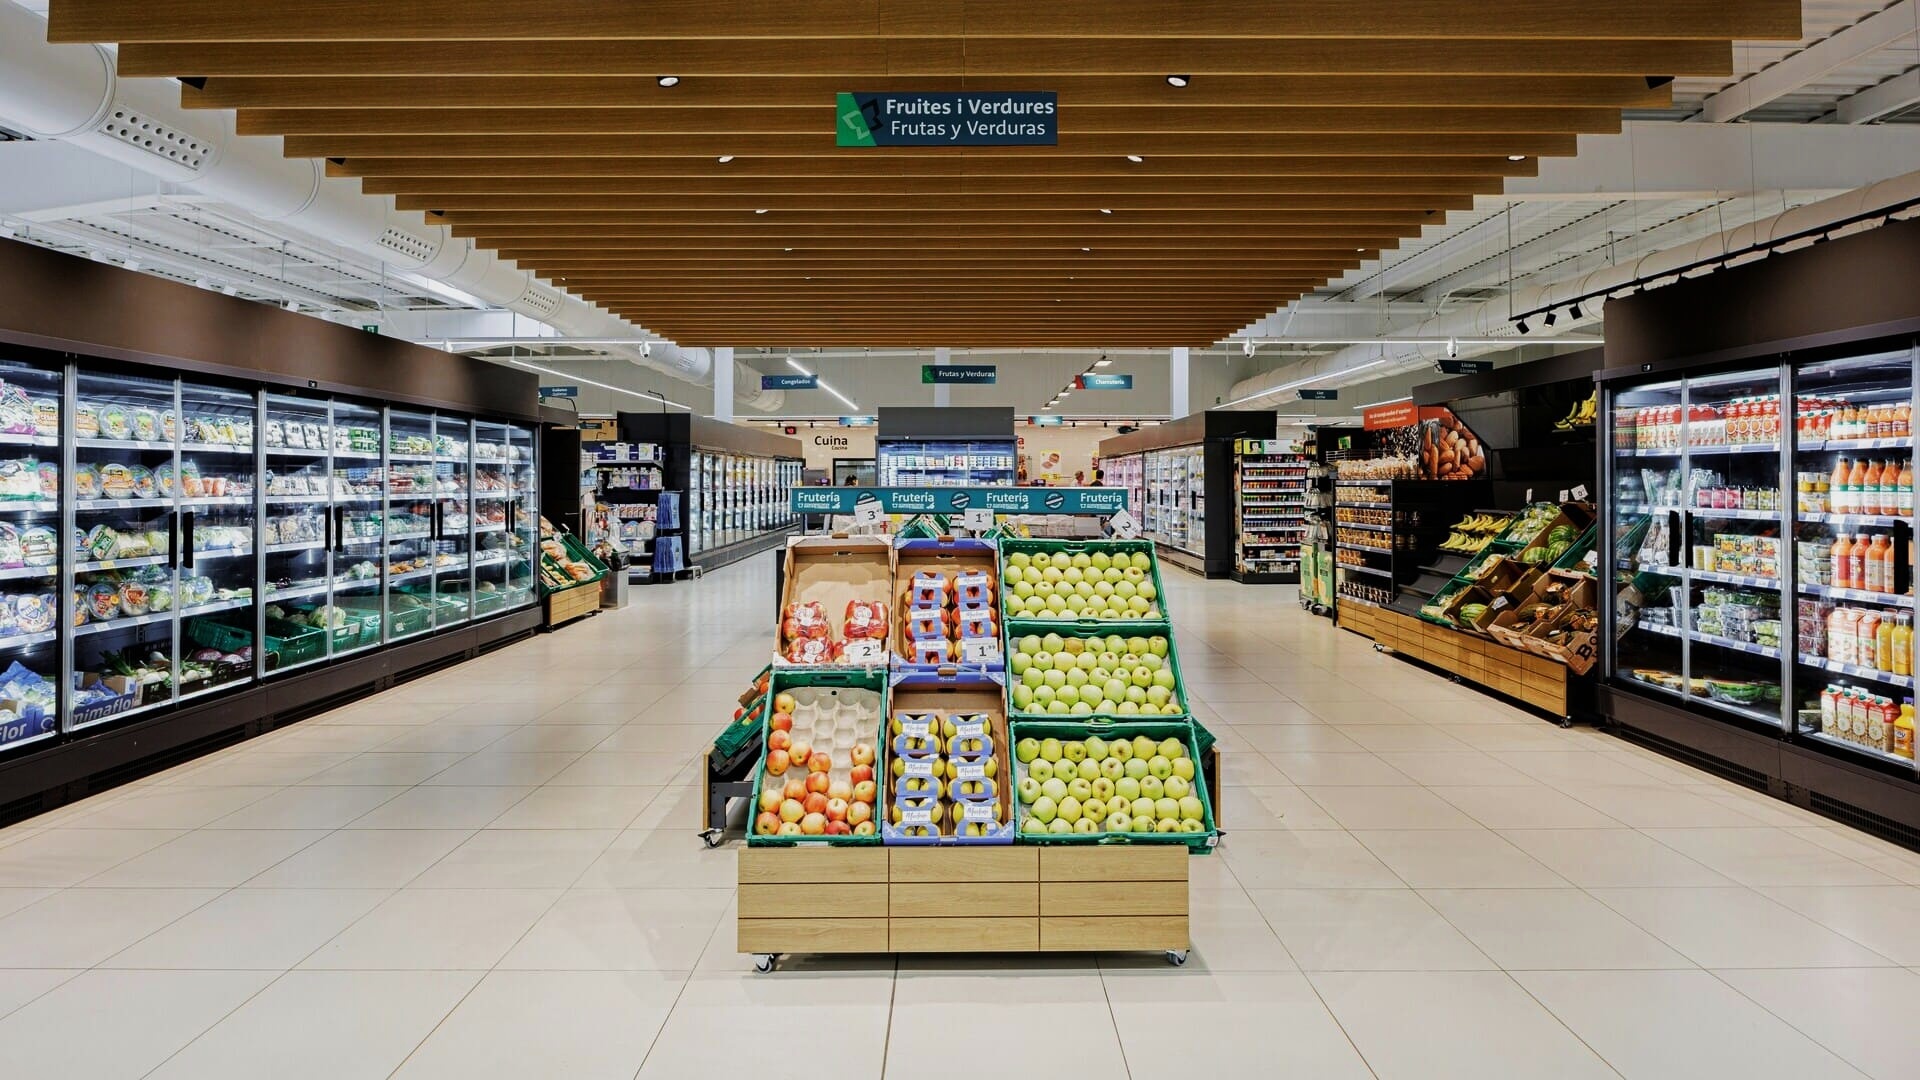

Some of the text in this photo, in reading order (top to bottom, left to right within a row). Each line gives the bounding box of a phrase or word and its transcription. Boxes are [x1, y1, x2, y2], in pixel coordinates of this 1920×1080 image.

[886, 98, 1054, 115] Fruites i Verdures
[891, 120, 1046, 140] Frutas y Verduras
[966, 370, 995, 378] Verduras
[814, 435, 848, 446] Cuina
[797, 491, 840, 502] Frutería
[892, 491, 935, 502] Frutería
[986, 491, 1029, 502] Frutería
[1080, 491, 1122, 502] Frutería
